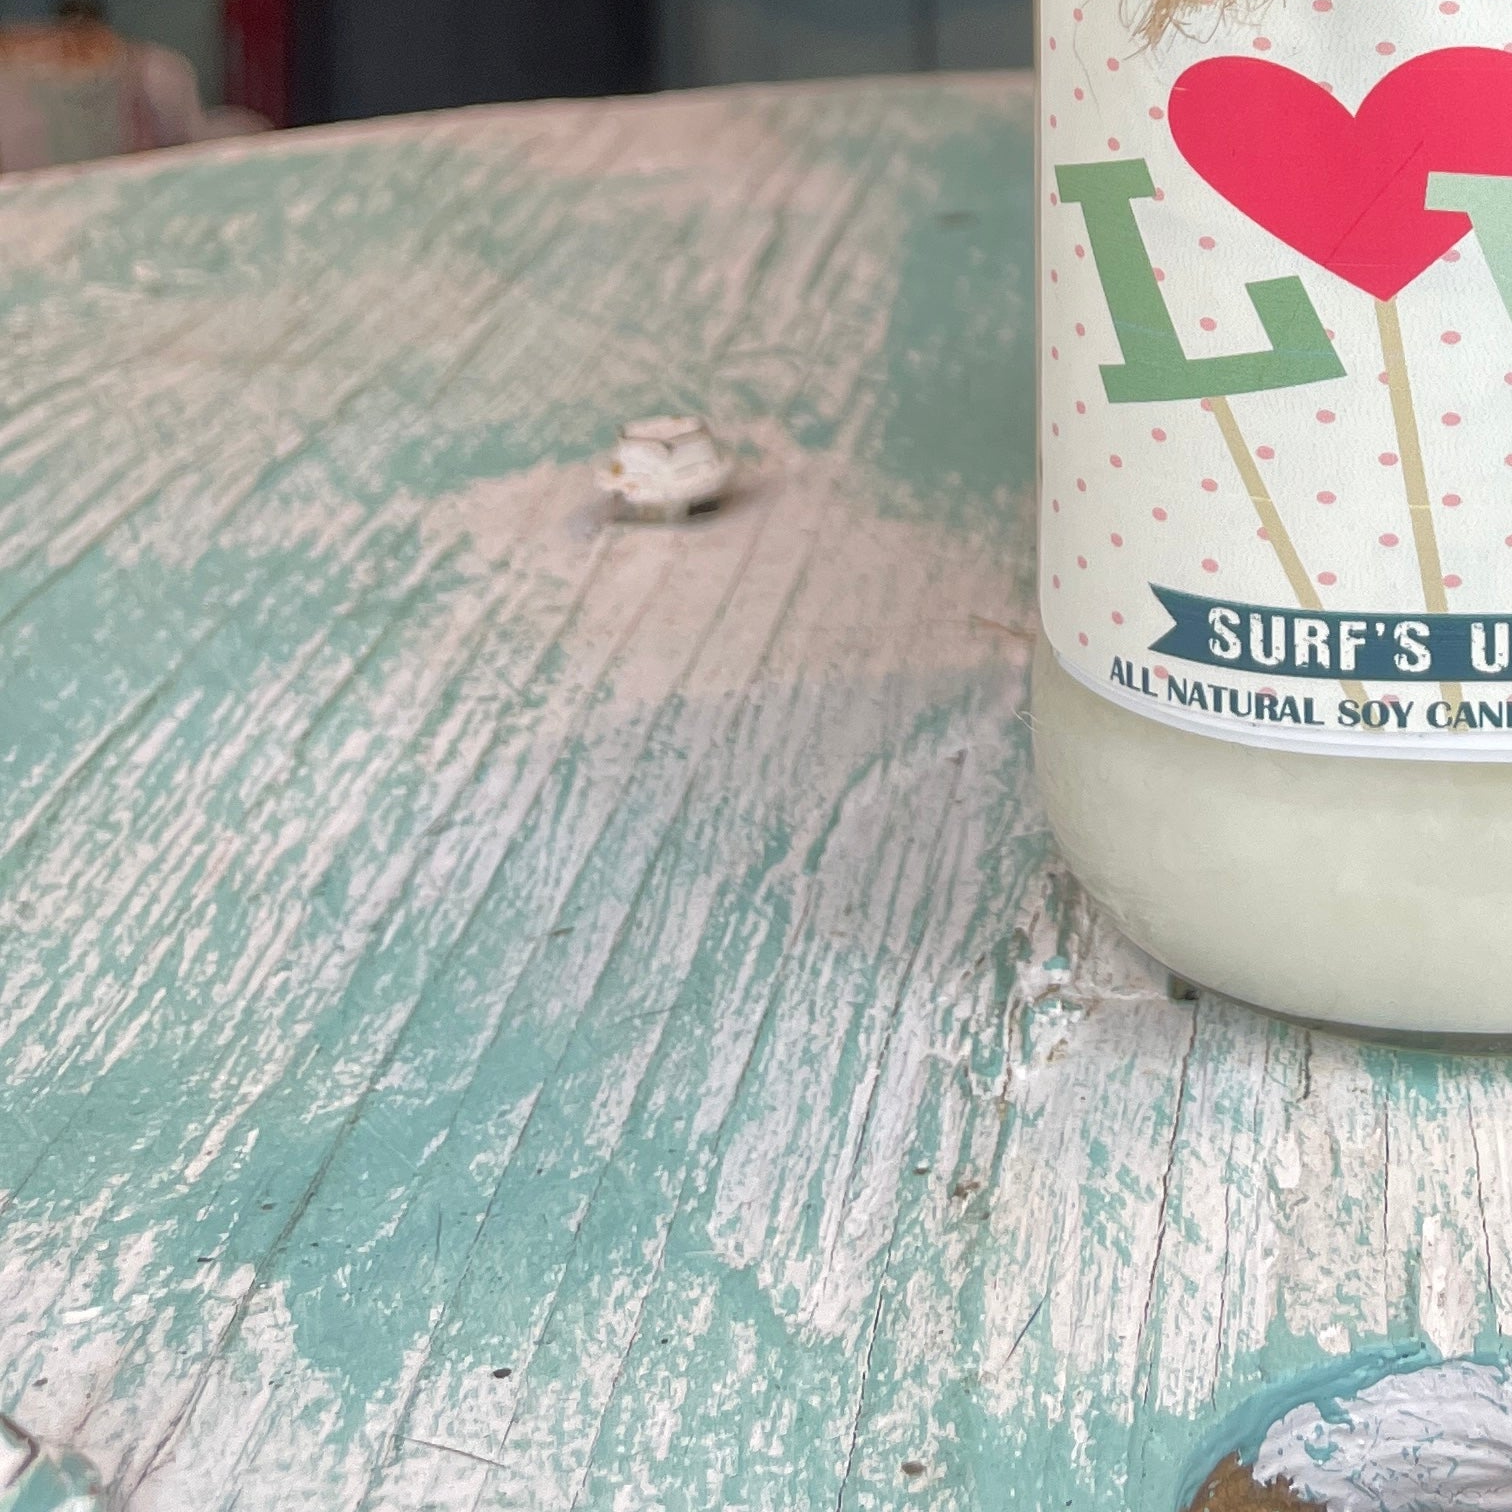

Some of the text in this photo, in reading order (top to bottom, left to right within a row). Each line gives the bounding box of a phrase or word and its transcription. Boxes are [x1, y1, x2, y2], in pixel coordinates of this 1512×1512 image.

[1207, 605, 1433, 674] SURF'S
[1109, 655, 1158, 698] ALL
[1166, 672, 1325, 726] NATURAL
[1337, 697, 1415, 729] SOY
